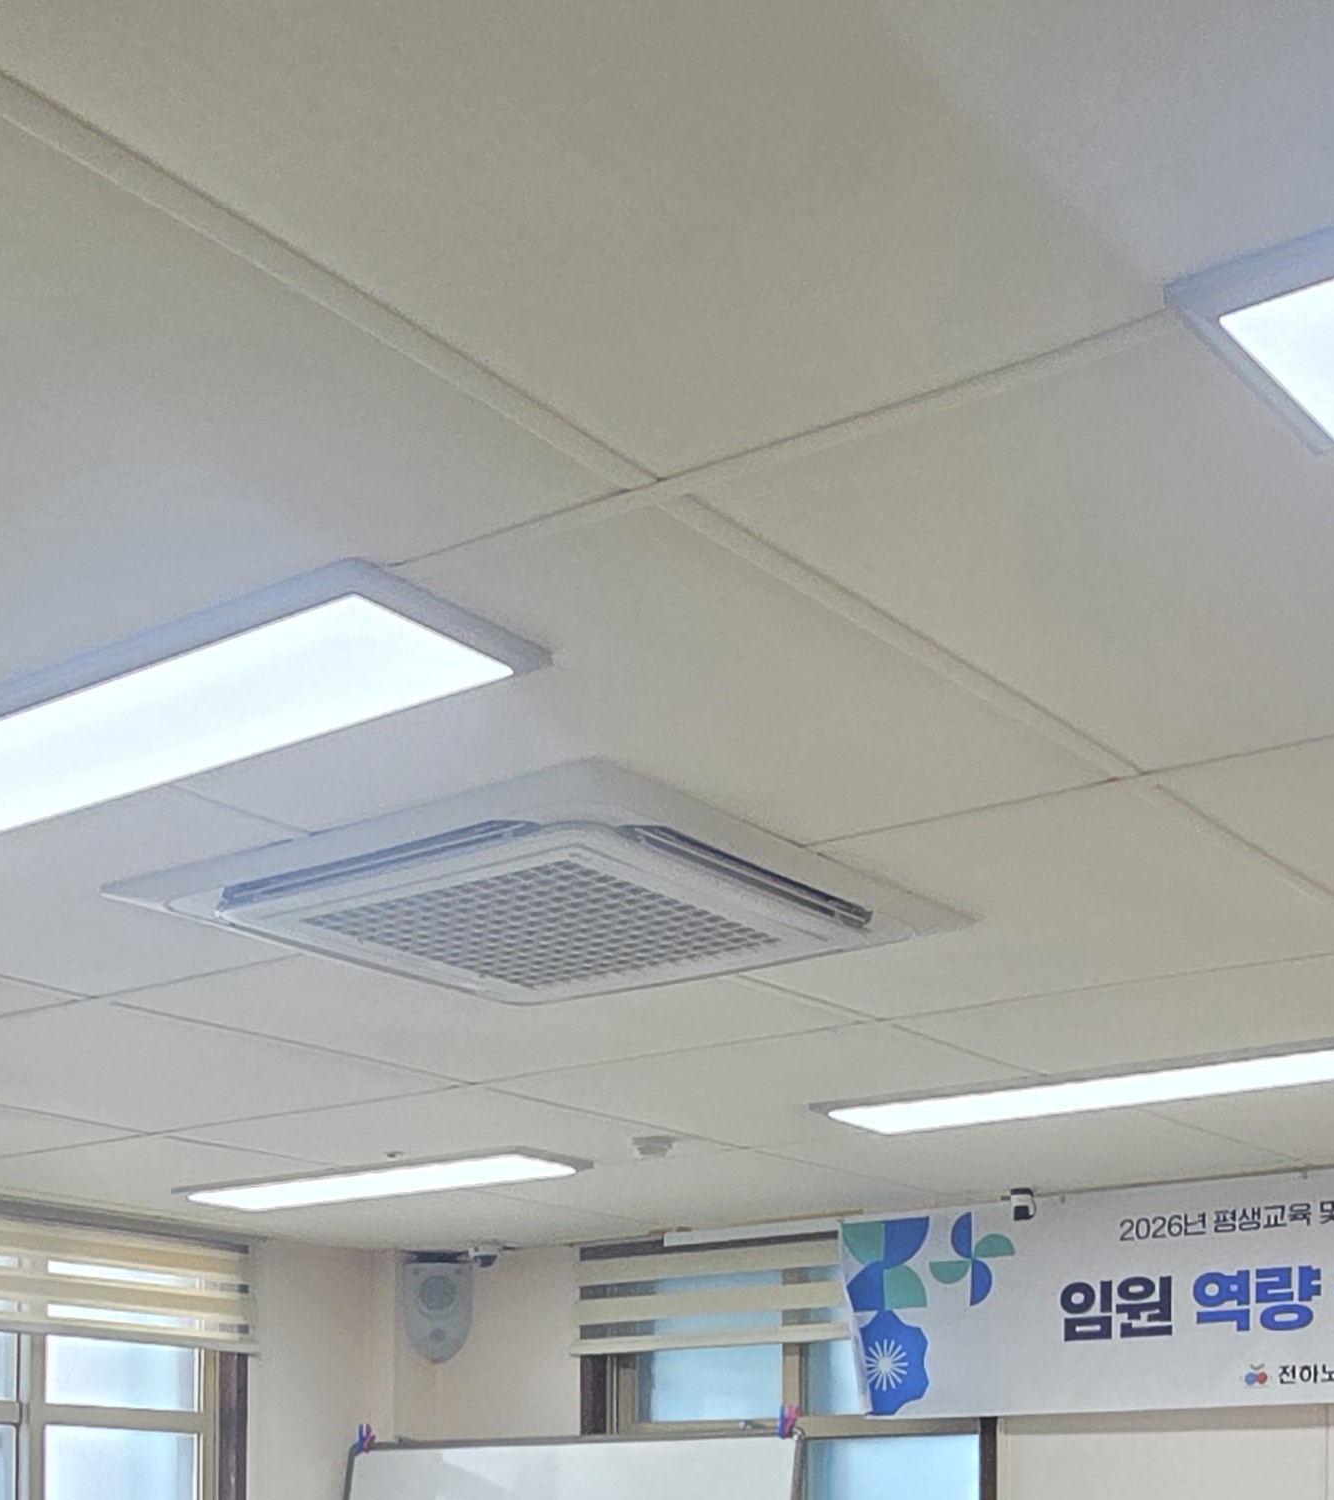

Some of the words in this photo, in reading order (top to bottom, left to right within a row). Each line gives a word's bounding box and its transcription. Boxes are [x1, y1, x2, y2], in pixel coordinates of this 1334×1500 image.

[1119, 1211, 1206, 1242] 2026년
[1212, 1202, 1312, 1235] 평생교육
[1058, 1275, 1174, 1342] 임원
[1191, 1264, 1323, 1332] 역량
